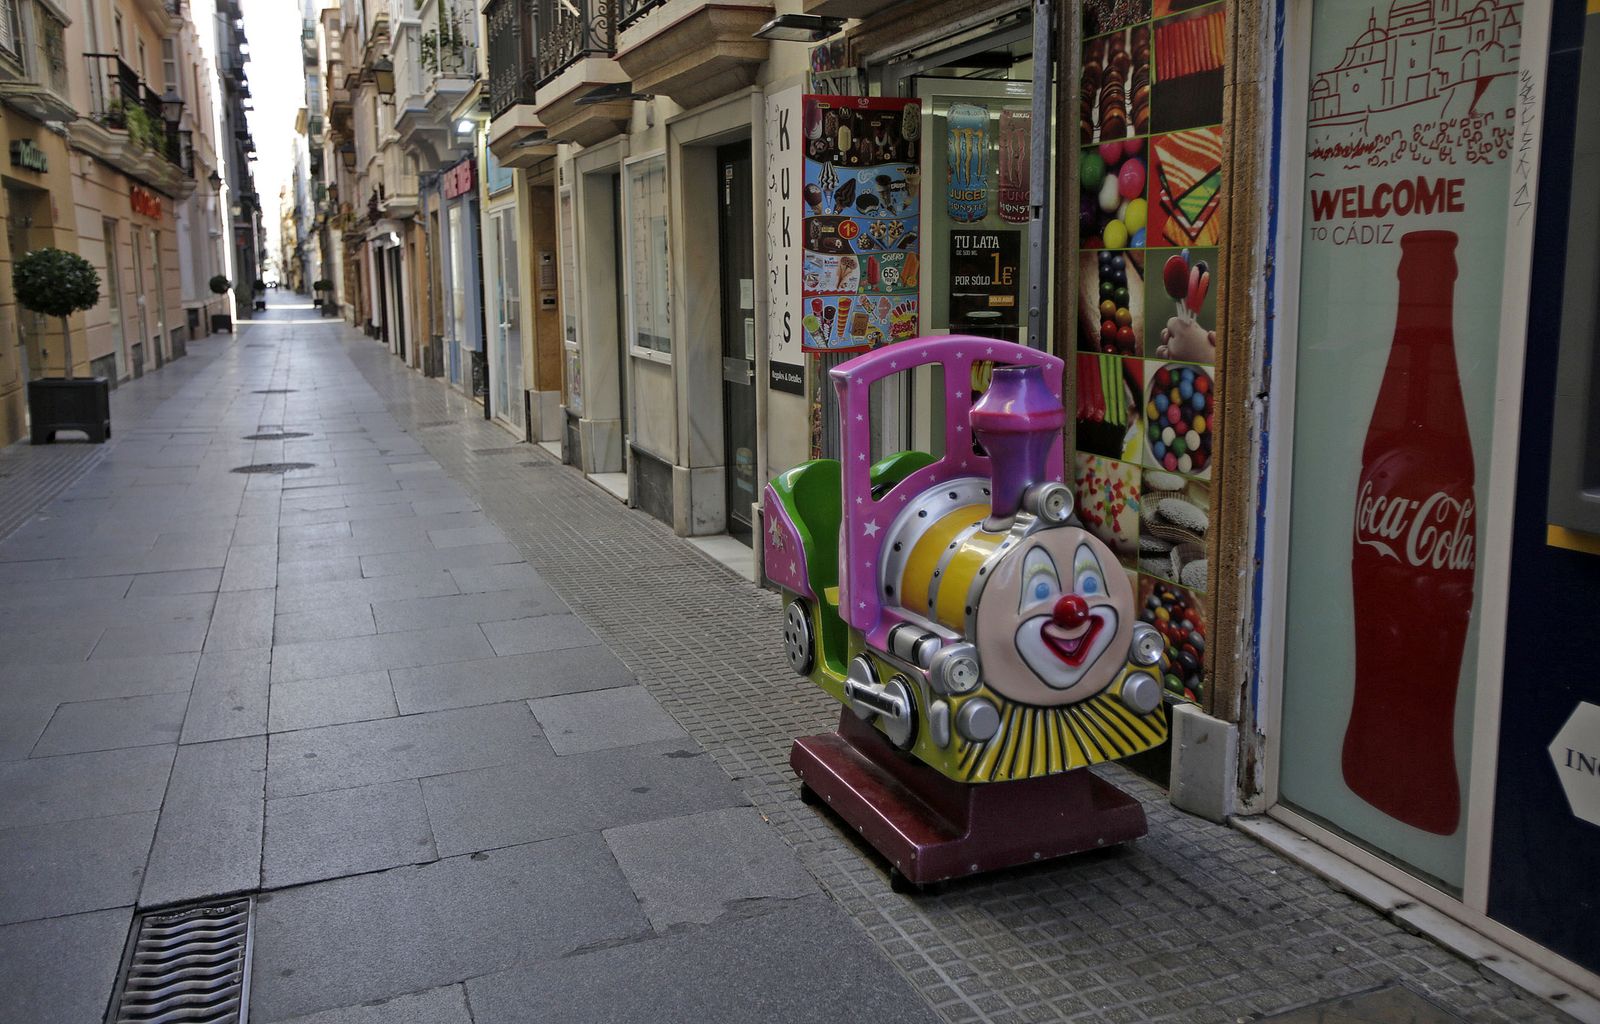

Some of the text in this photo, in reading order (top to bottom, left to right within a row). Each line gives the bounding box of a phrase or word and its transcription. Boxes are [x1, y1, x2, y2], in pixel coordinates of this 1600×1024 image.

[1311, 176, 1465, 222] WELCOME
[954, 235, 1000, 249] TU LATA
[1311, 221, 1394, 246] TO CÁDIZ
[955, 275, 970, 286] POR
[1355, 480, 1475, 570] Coca-Cola
[1564, 747, 1600, 777] IN
